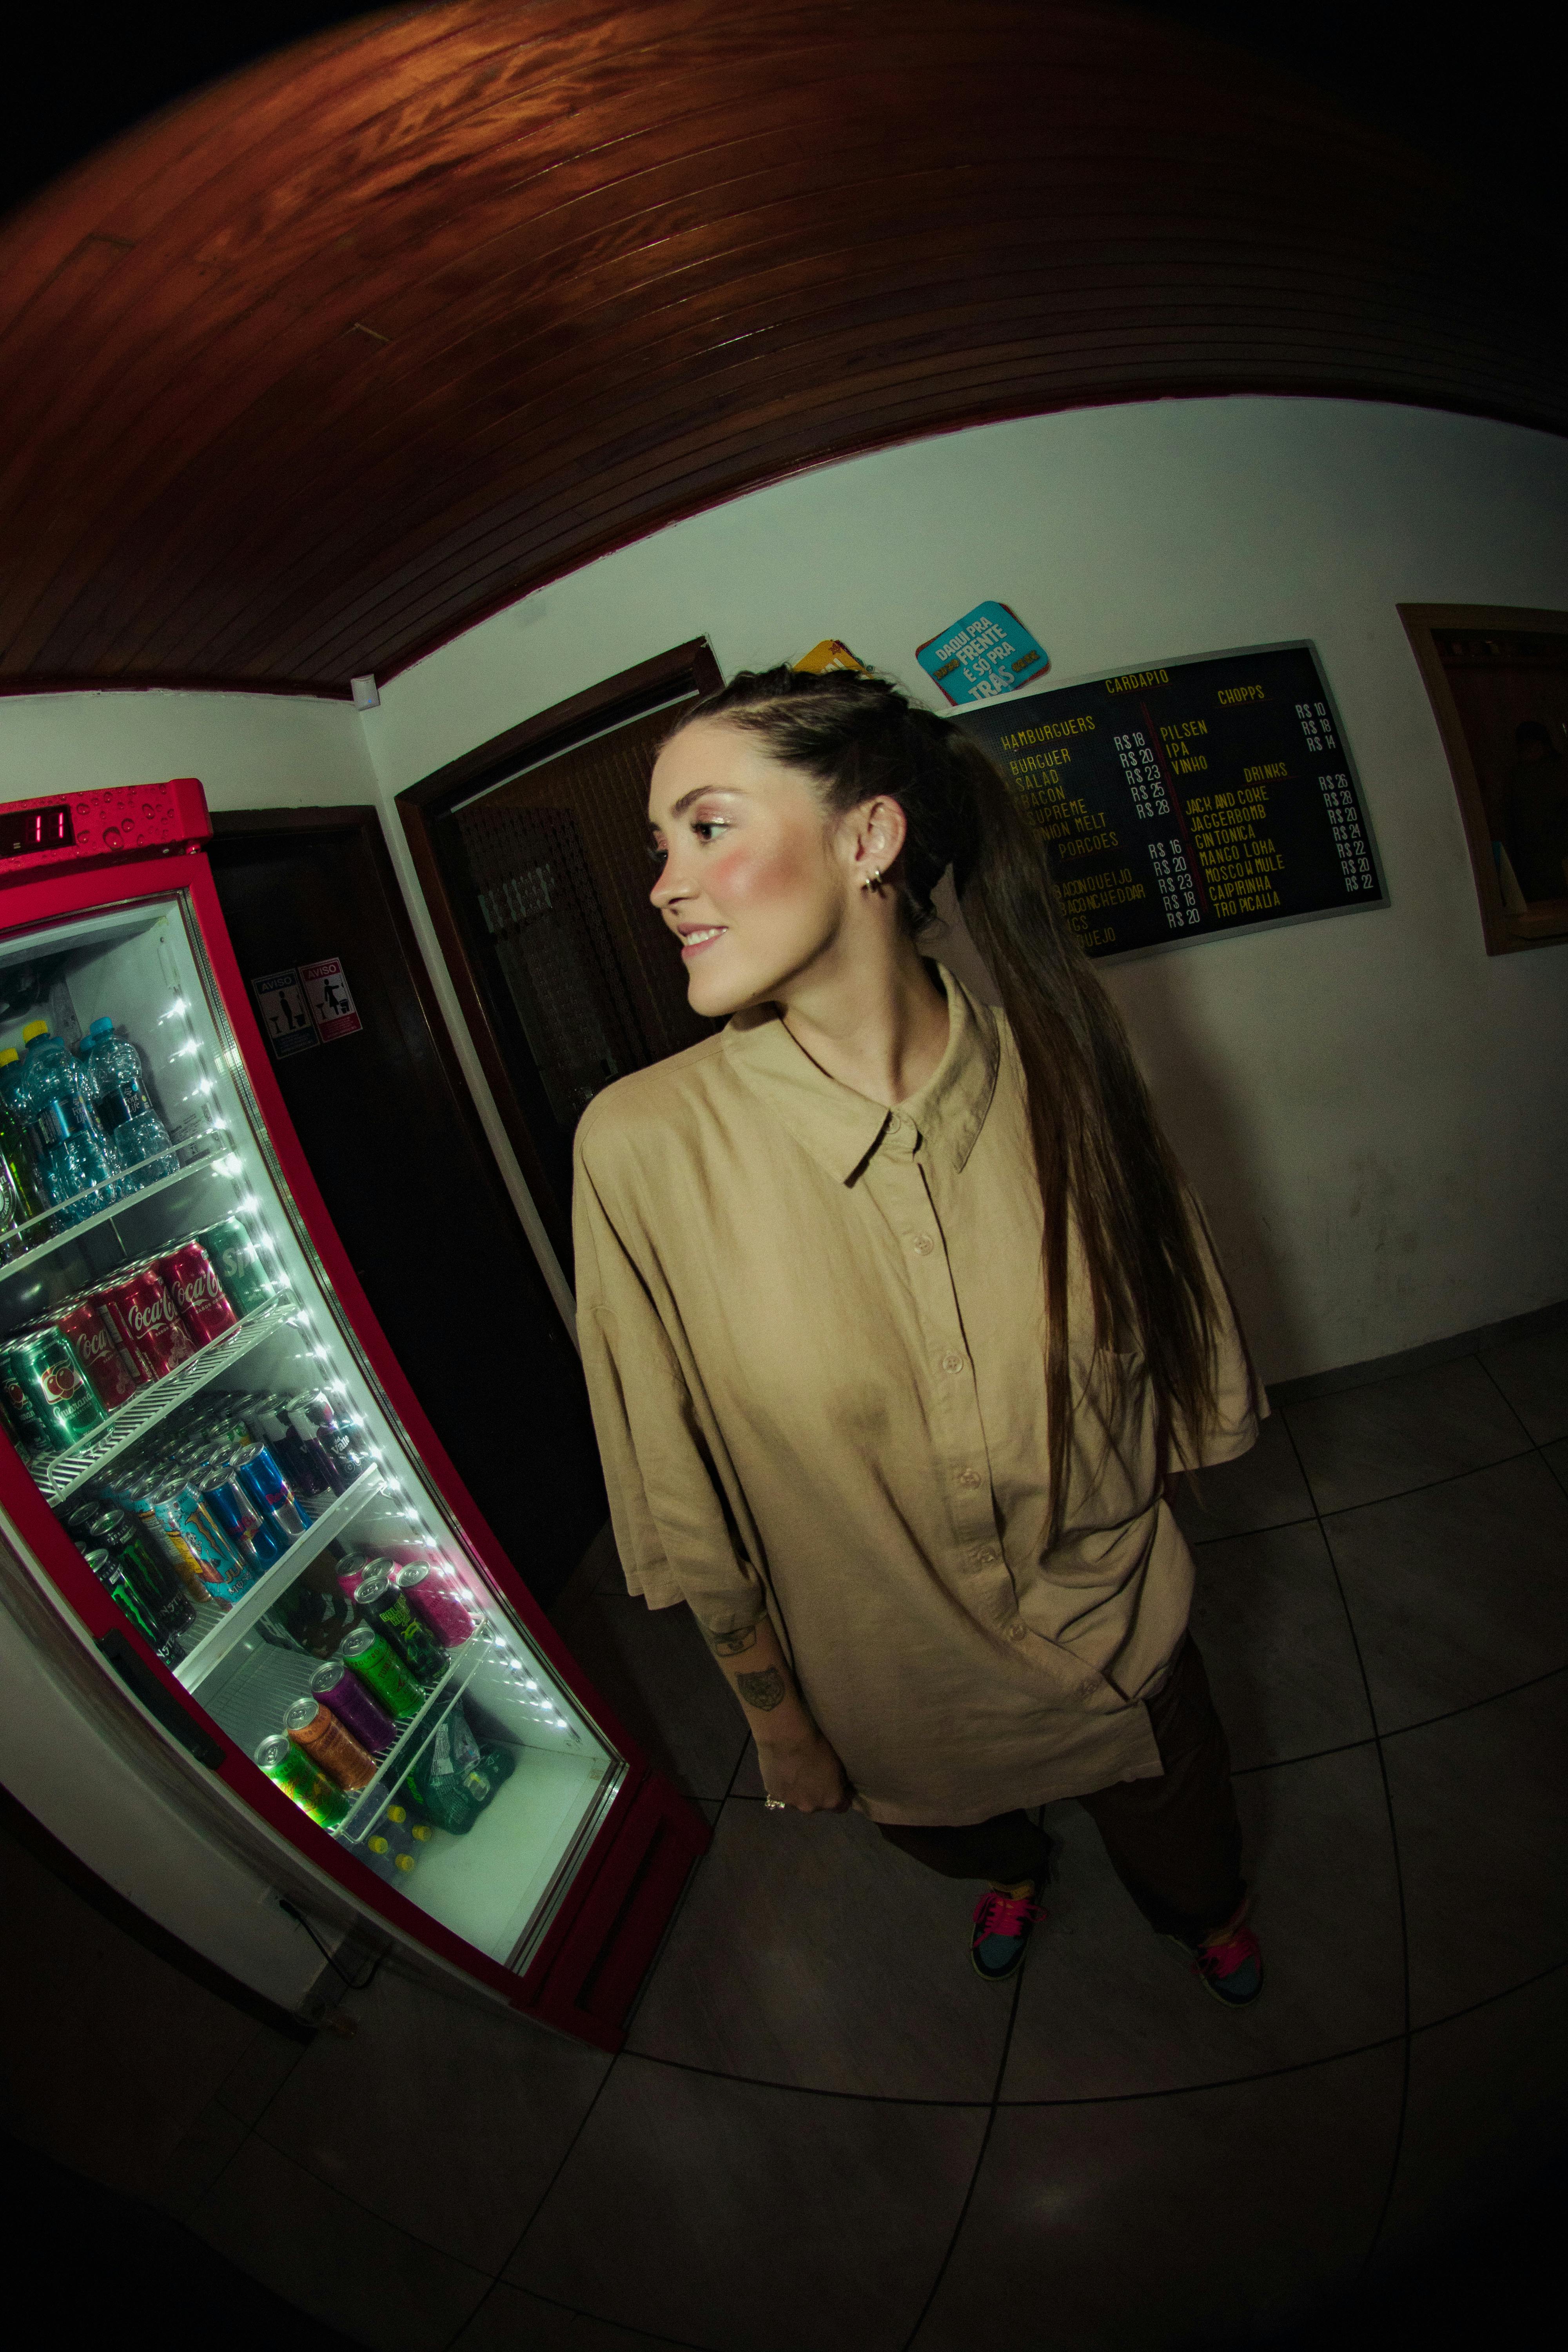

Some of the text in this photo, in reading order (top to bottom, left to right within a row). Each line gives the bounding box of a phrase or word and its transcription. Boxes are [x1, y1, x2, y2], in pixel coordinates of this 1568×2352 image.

[935, 616, 993, 661] DAQUI PRA
[955, 623, 1008, 666] FRENTE
[963, 641, 1016, 683] É SÓ PRA
[968, 665, 1015, 701] TRÁS
[1105, 669, 1170, 694] CARDAPIO
[1217, 684, 1265, 705] CHOPPS
[1294, 701, 1327, 720] R$ 10
[1000, 715, 1096, 751] HAMBURGUERS
[1160, 719, 1209, 742] PILSEN
[1300, 718, 1332, 736] R$ 18
[1113, 731, 1146, 751] R$ 18
[1165, 740, 1190, 759] IPA
[1305, 734, 1337, 753] R$ 14
[1009, 748, 1072, 776] BURGUER
[1119, 748, 1154, 769] R$ 20
[1171, 754, 1209, 776] VINHO
[1015, 769, 1060, 792] SALAD
[1125, 764, 1161, 785] R$ 23
[1242, 761, 1289, 784] DRINKS
[1318, 773, 1349, 791] R$ 26
[1019, 785, 1066, 811] BACON
[1130, 781, 1165, 802] R$ 25
[1185, 785, 1270, 816] JACK AND COKE
[1323, 789, 1354, 808] R$ 28
[1027, 798, 1088, 826] SUPREME
[1136, 799, 1171, 820] R$ 28
[1190, 803, 1267, 833] JAGGERBOMB
[1327, 806, 1359, 825] R$ 20
[36, 812, 64, 842] 11
[1074, 811, 1107, 833] MELT
[1332, 823, 1362, 842] R$ 24
[1058, 830, 1119, 859] PORCOES
[1148, 839, 1182, 860] R$ 16
[1198, 838, 1276, 867] MANGO LOKA
[1336, 840, 1367, 859] R$ 22
[1153, 856, 1187, 877] R$ 20
[1254, 853, 1286, 873] MULE
[1341, 857, 1370, 876] R$ 20
[1158, 873, 1193, 894] R$ 23
[1208, 875, 1272, 902] CAIPIRINHA
[1345, 874, 1374, 893] R$ 22
[1162, 891, 1196, 911] R$ 18
[1166, 908, 1201, 929] R$ 20
[308, 964, 337, 979] AVISO
[261, 976, 292, 992] AVISO
[196, 1303, 212, 1314] SABOR
[331, 1435, 350, 1454] Valle
